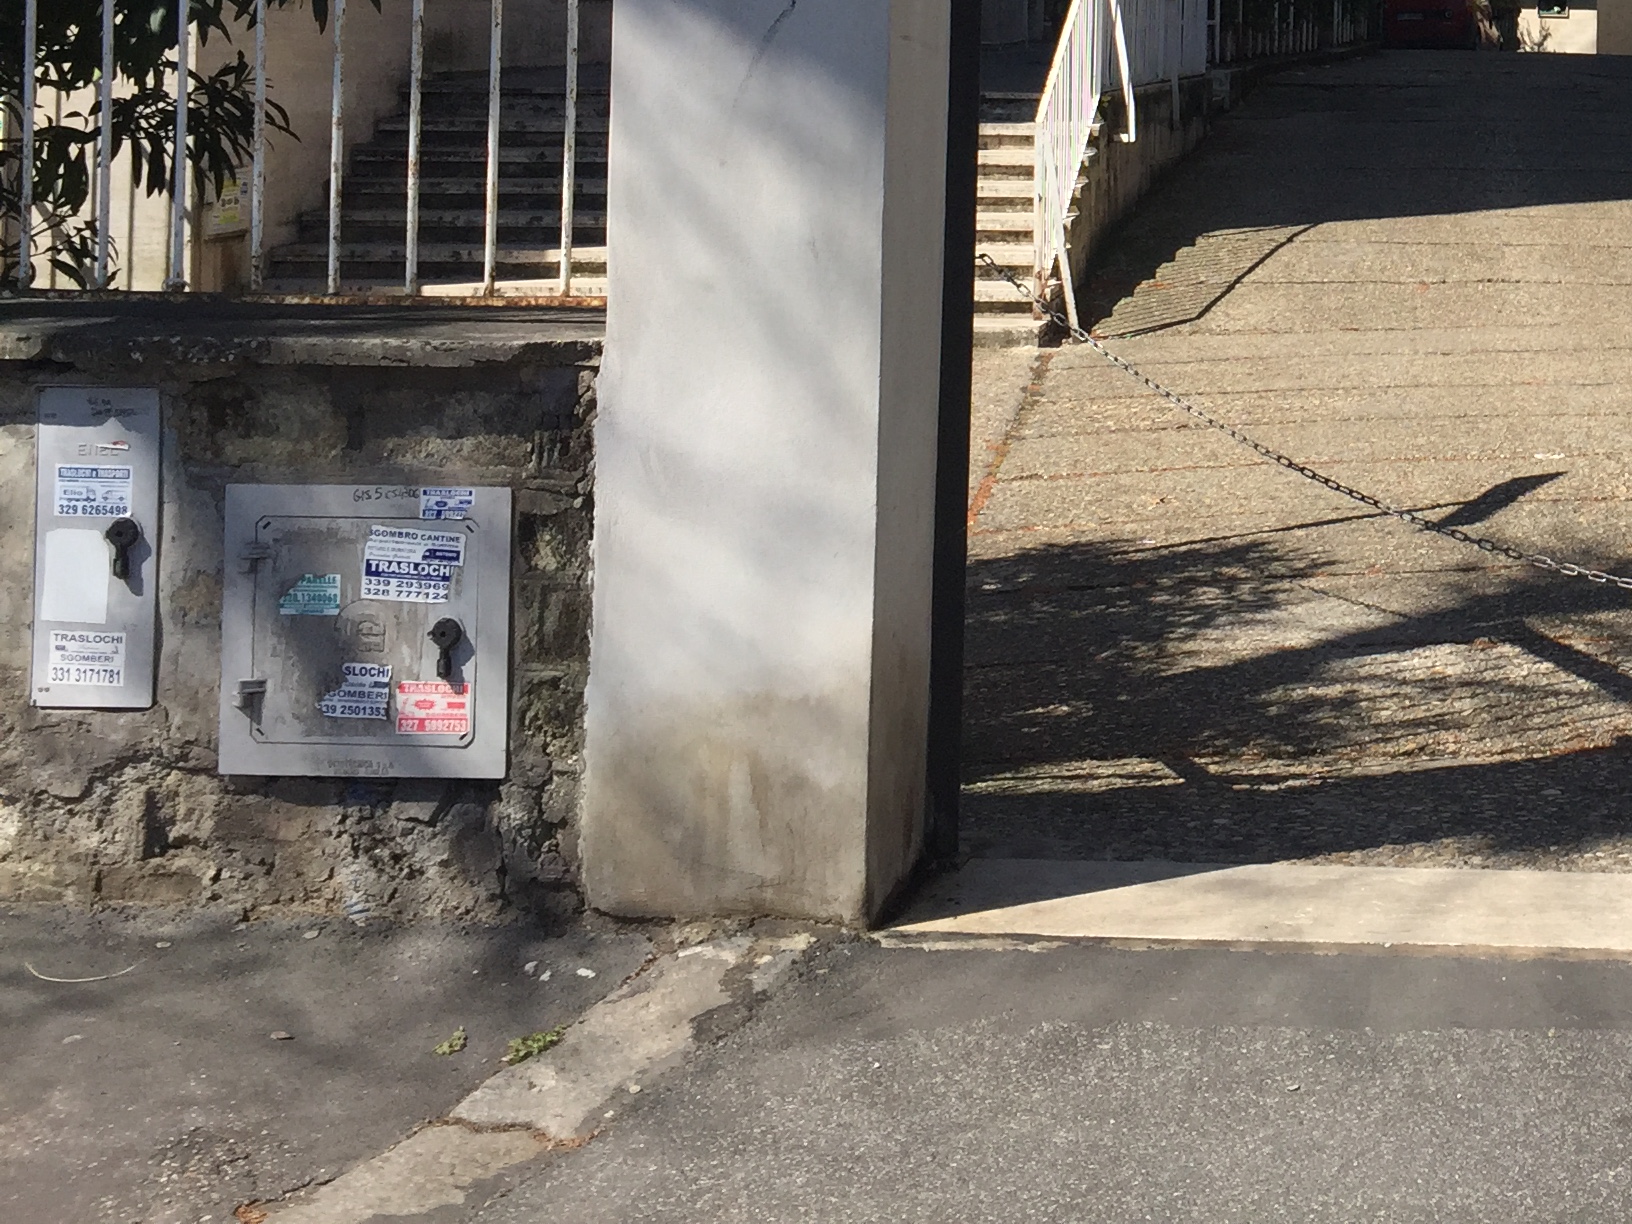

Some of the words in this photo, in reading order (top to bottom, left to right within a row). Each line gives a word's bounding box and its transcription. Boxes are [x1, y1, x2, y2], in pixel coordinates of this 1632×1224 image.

[58, 504, 78, 514] 329
[82, 504, 128, 516] 6265498
[420, 534, 460, 544] CANTINE
[364, 578, 391, 586] 339
[364, 588, 390, 596] 328
[54, 633, 122, 644] TRASLOCHI
[60, 654, 114, 663] SGOMBERI
[52, 666, 70, 682] 331
[75, 668, 120, 684] 3171781
[344, 666, 390, 678] SLOCHI
[404, 684, 463, 693] TRASLOCHI
[400, 720, 420, 732] 327
